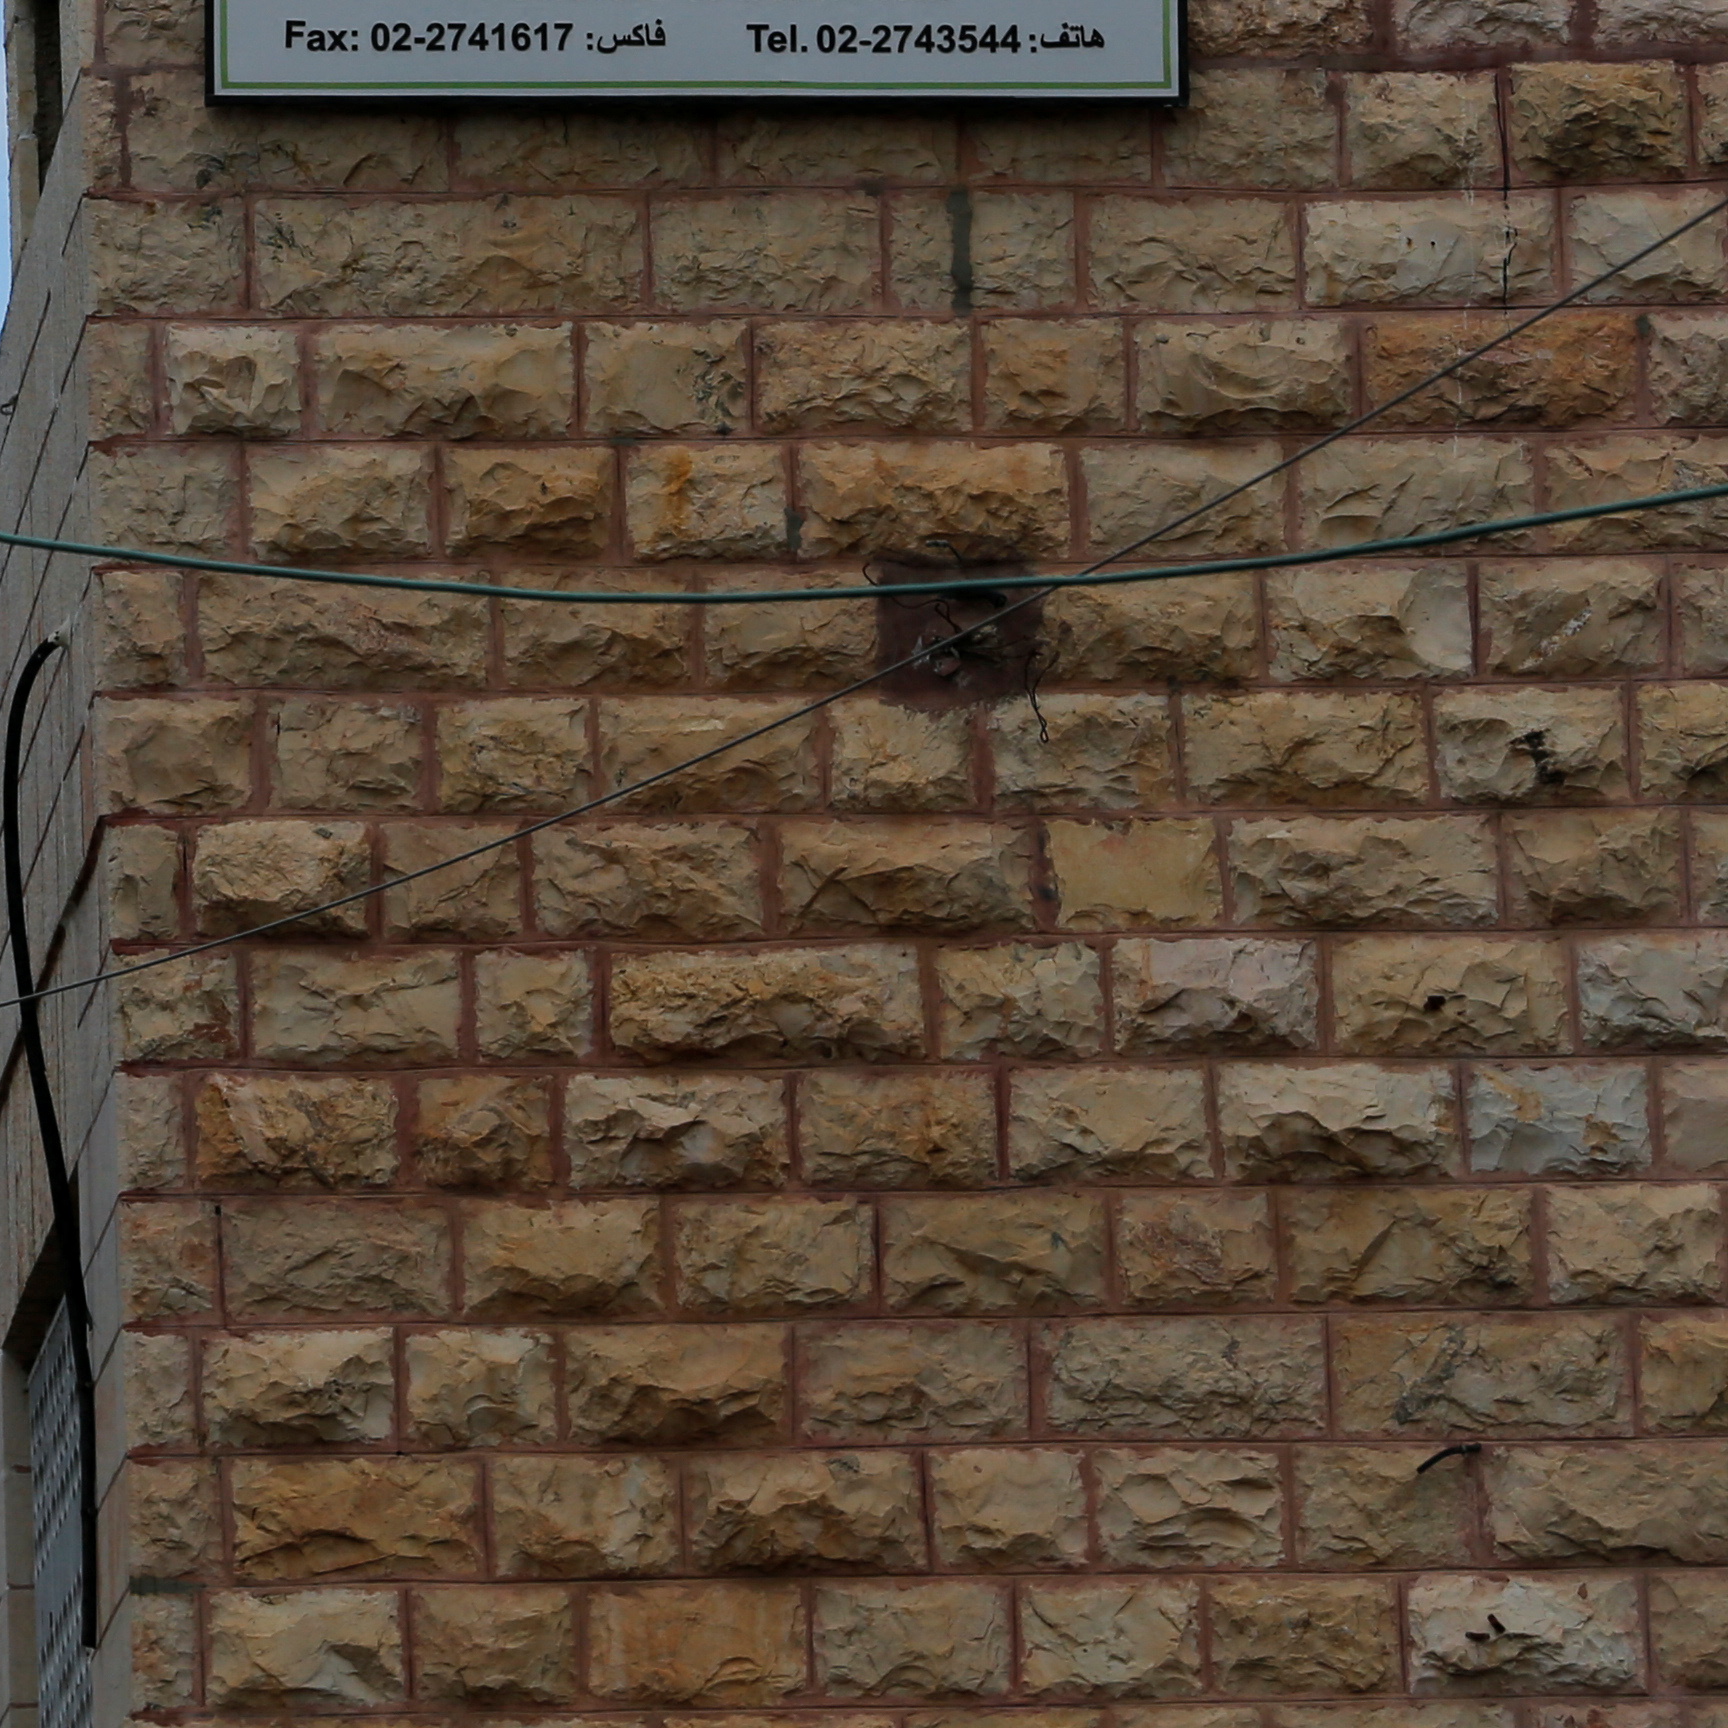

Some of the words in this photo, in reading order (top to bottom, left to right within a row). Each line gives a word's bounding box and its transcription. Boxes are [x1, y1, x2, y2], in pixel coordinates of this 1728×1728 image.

[285, 20, 358, 52] Fax:
[371, 22, 573, 52] 02-2741617
[746, 24, 808, 53] Tel.
[817, 24, 1021, 54] 02-2743544
